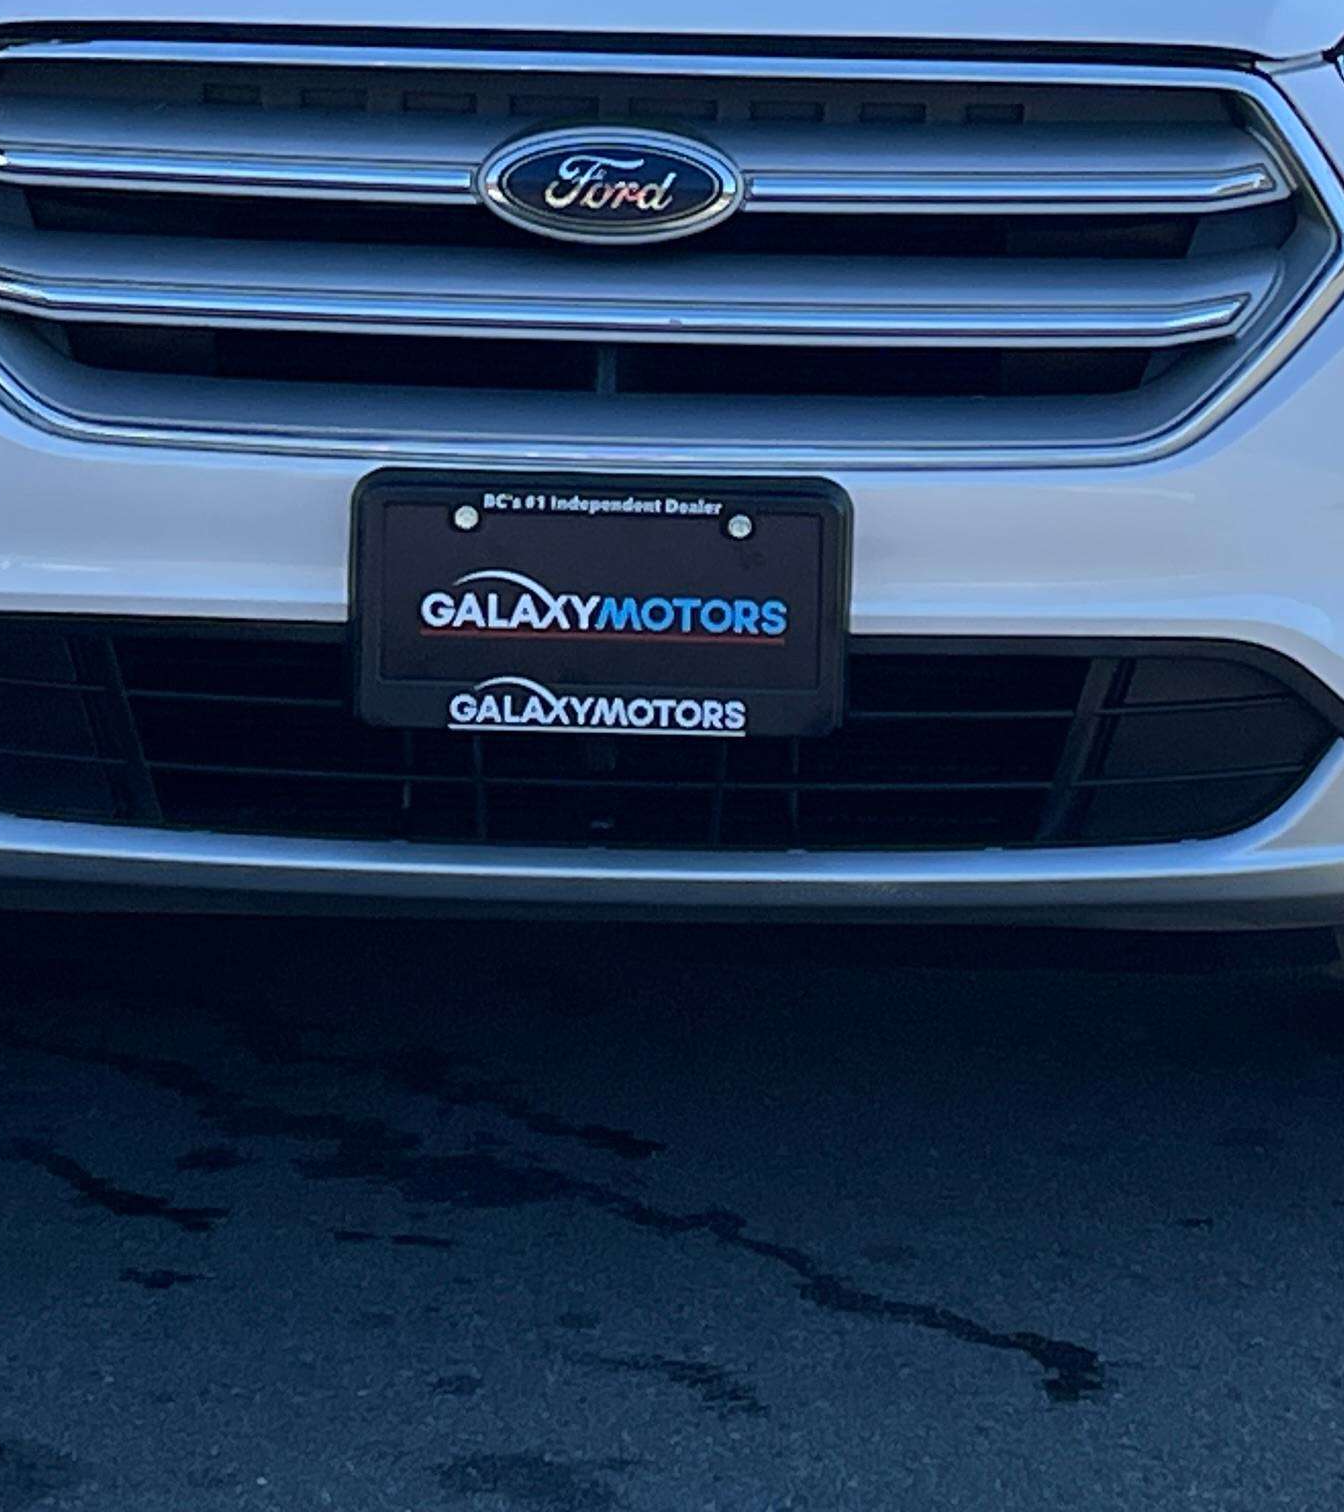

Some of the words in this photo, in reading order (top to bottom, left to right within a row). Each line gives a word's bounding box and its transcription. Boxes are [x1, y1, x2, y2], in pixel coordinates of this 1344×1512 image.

[545, 155, 677, 209] Ford
[483, 493, 522, 509] BC's
[525, 494, 545, 509] #1
[551, 495, 661, 514] Independent
[665, 498, 723, 515] Dealer
